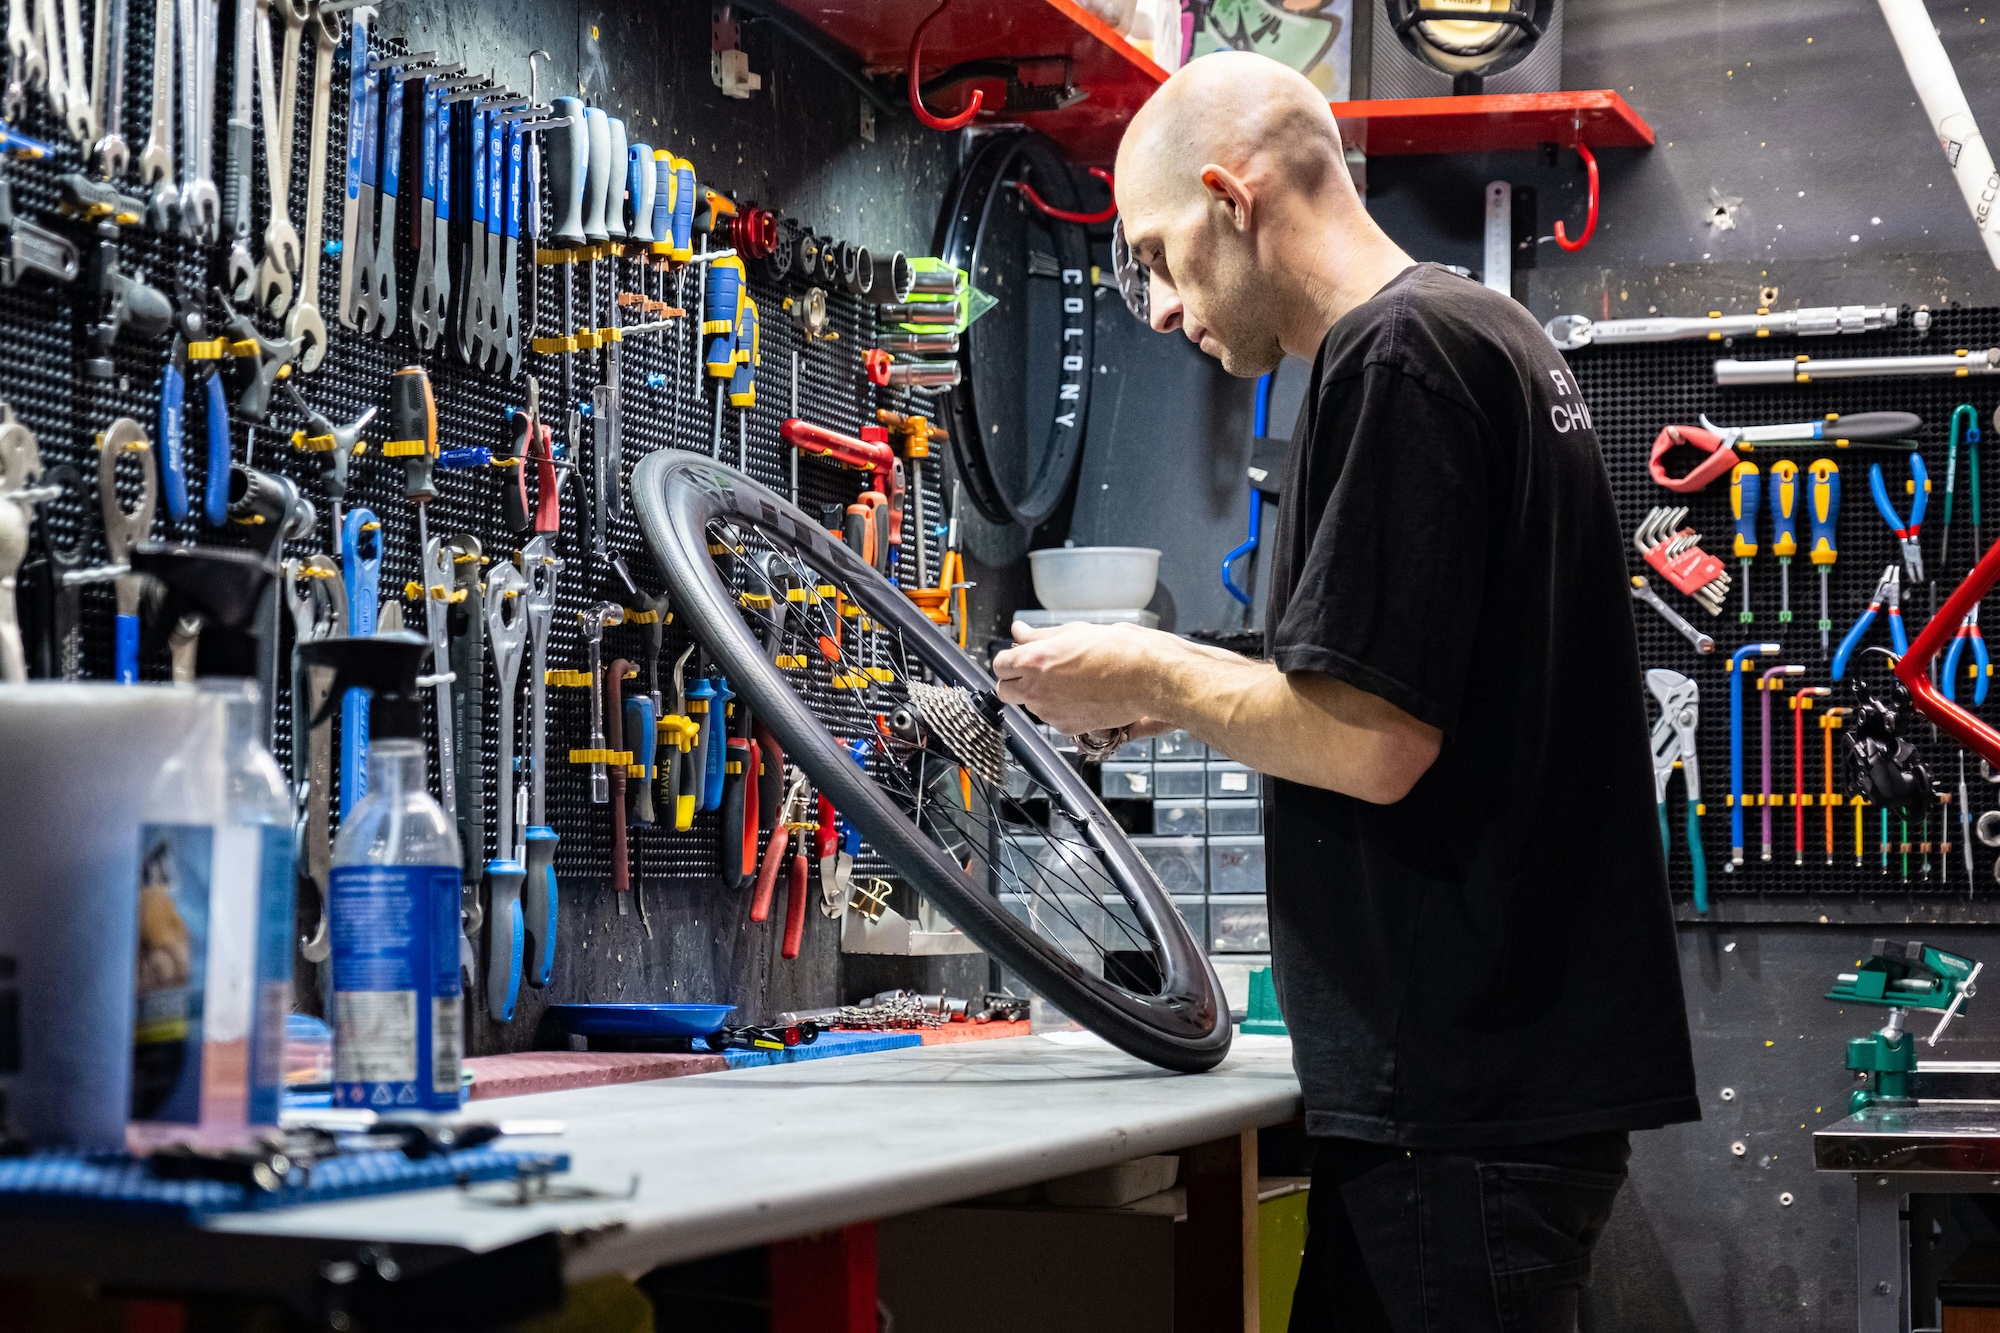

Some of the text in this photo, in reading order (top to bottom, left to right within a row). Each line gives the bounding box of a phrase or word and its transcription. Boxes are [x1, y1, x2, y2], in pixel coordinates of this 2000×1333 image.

[1976, 170, 2000, 223] RECO
[1055, 268, 1084, 428] COLONY
[660, 758, 672, 805] STAYER
